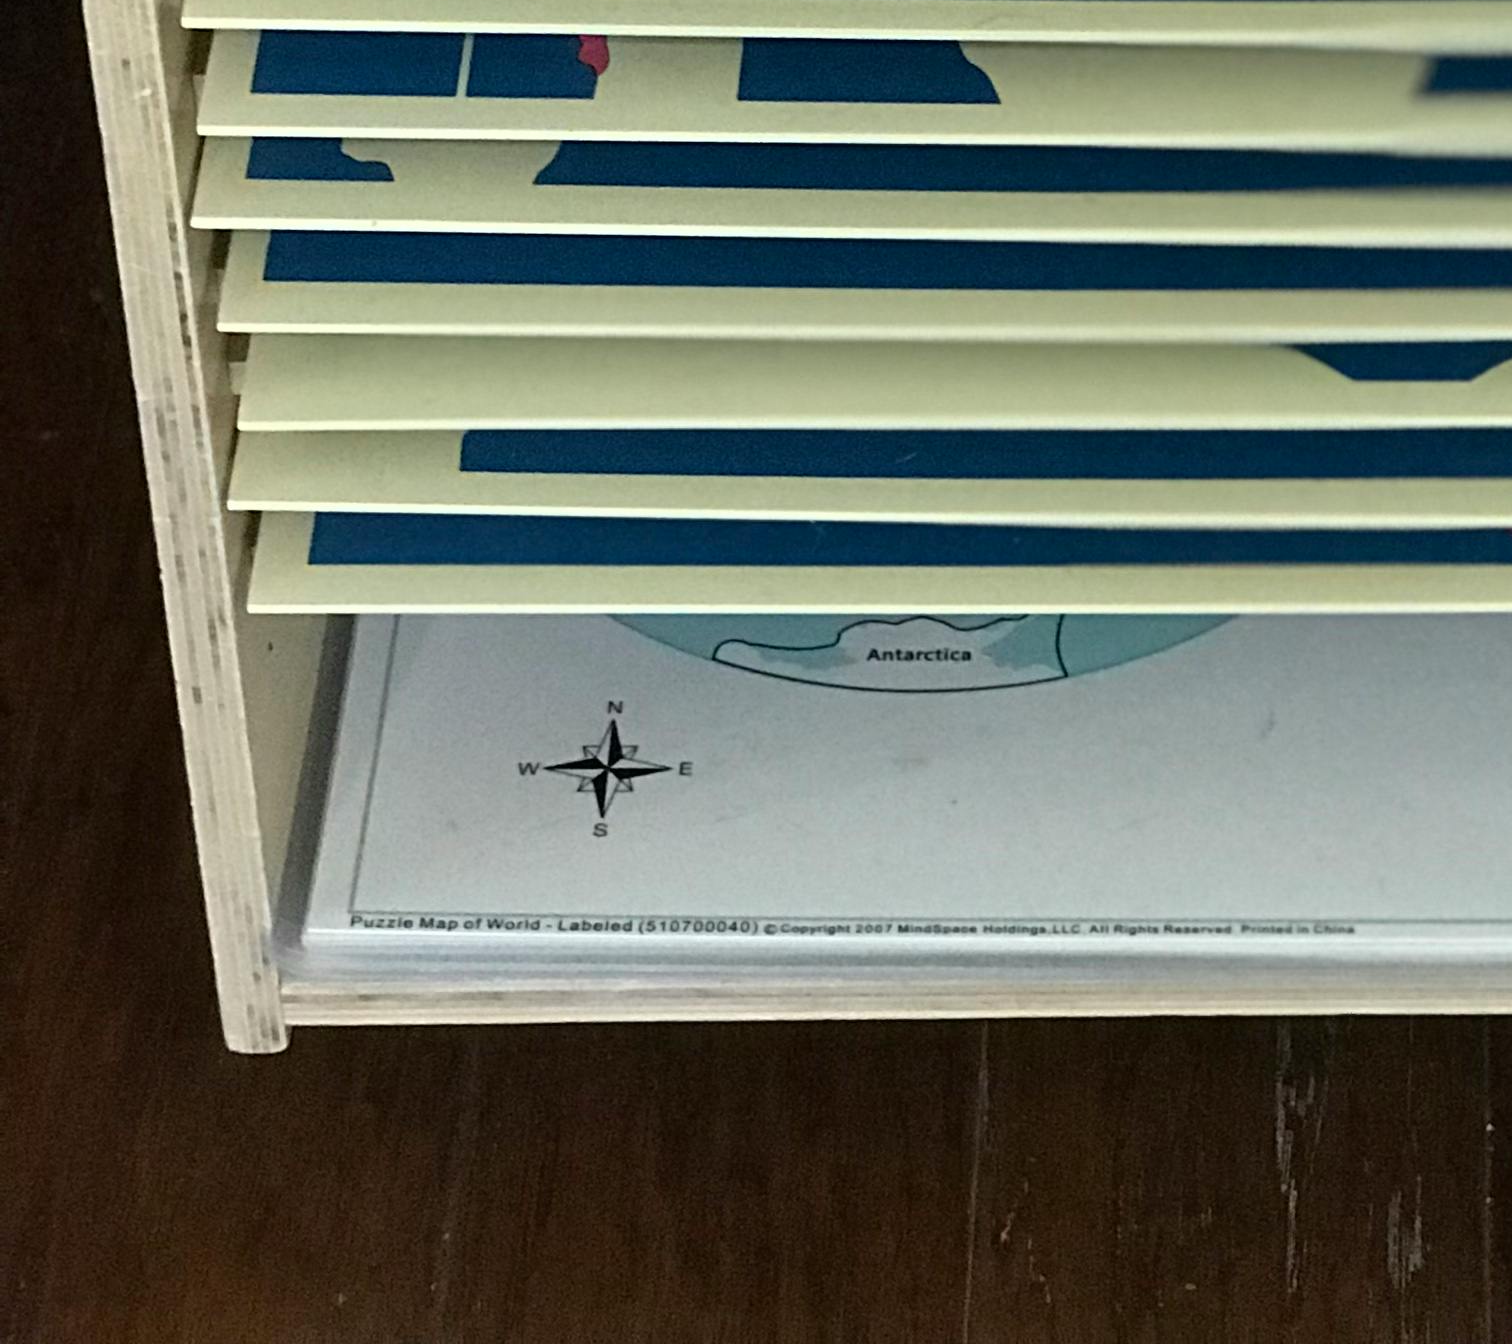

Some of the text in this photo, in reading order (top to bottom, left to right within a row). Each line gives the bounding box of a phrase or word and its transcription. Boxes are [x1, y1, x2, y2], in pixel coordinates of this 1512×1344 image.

[867, 648, 972, 661] Antarctica
[607, 700, 623, 714] N
[518, 761, 540, 776] W
[679, 761, 693, 776] E
[592, 823, 608, 837] S
[350, 915, 414, 929] Puzzle
[419, 917, 459, 931] Map
[463, 918, 483, 930] of
[487, 918, 541, 931] World
[557, 920, 633, 932] Labeled
[638, 920, 759, 935] (510700040)
[1113, 924, 1159, 936] Rights
[1241, 924, 1293, 935] Printed
[1296, 924, 1310, 934] in
[1313, 924, 1356, 935] China
